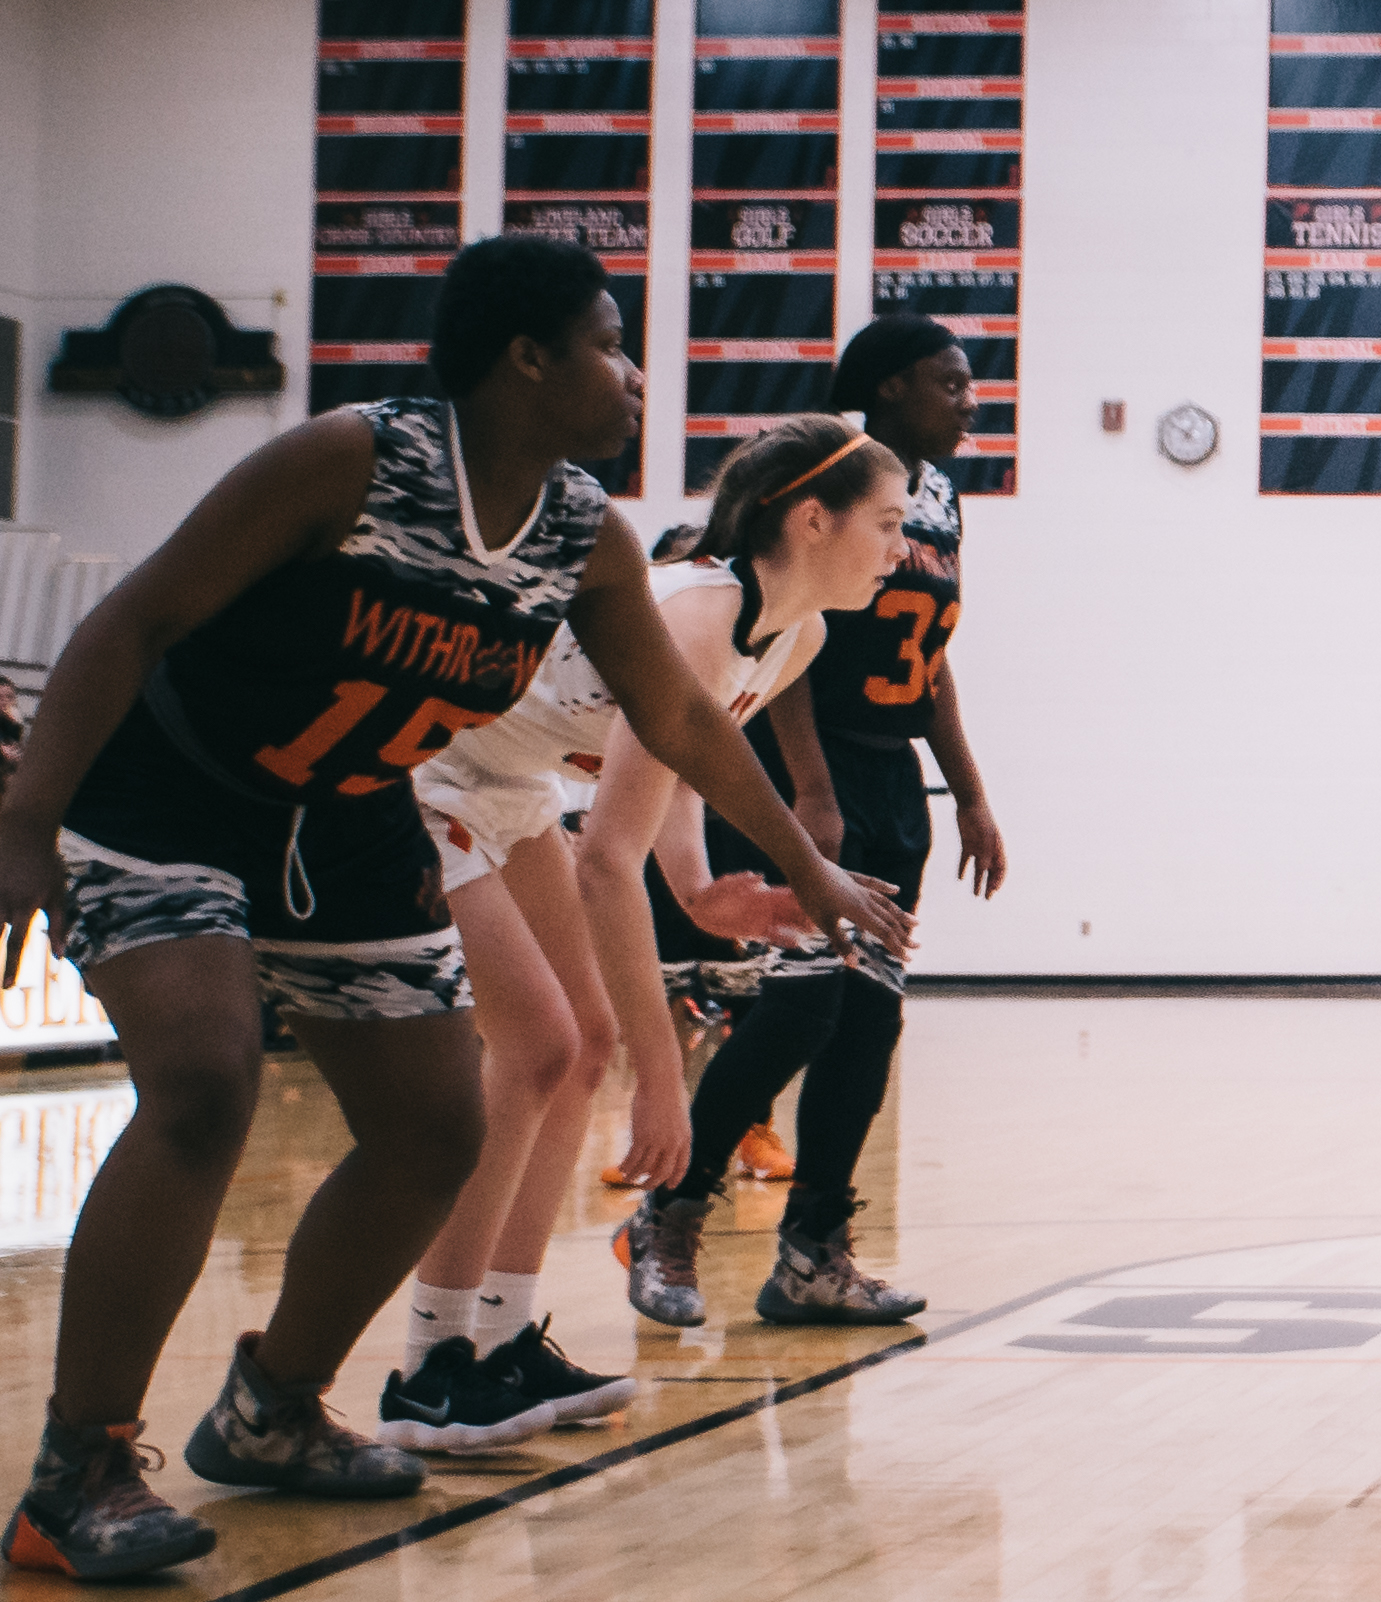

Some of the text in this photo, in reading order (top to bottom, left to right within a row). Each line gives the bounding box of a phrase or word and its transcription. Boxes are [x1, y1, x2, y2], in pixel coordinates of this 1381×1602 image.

[1315, 205, 1365, 221] GIRLS
[731, 221, 795, 248] GOLF
[901, 221, 993, 247] SOCCER
[253, 679, 502, 796] 15
